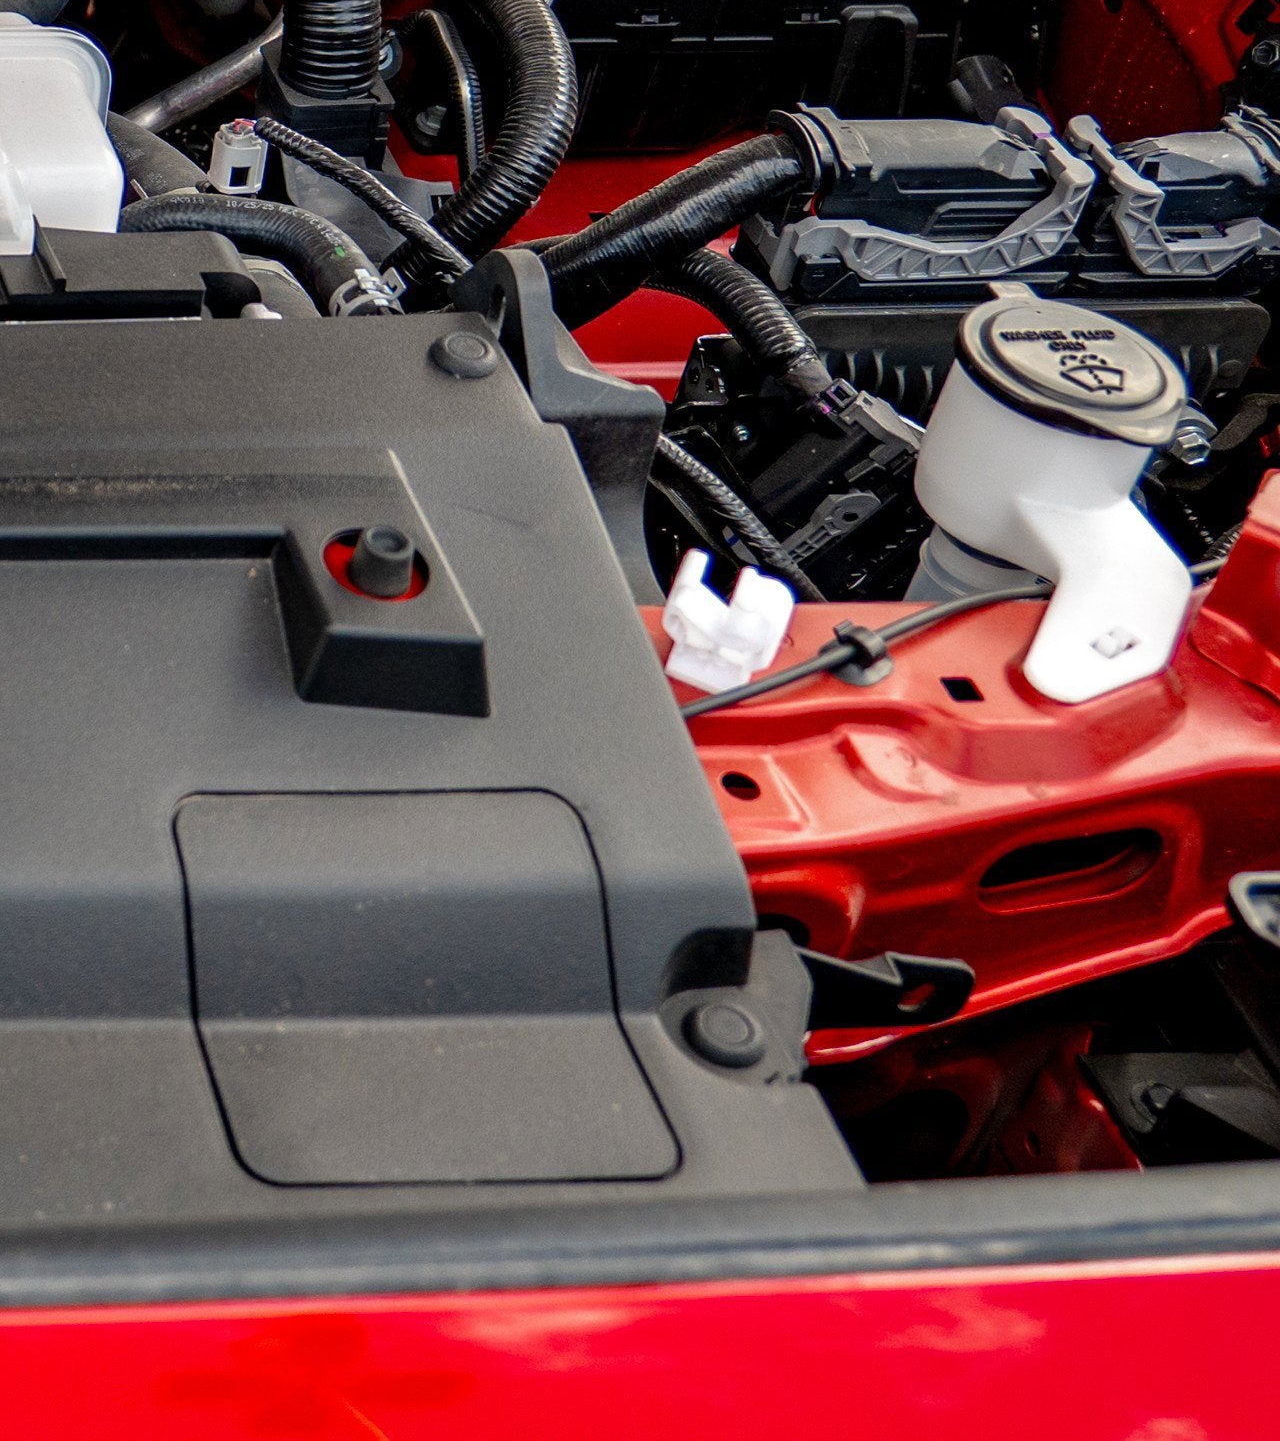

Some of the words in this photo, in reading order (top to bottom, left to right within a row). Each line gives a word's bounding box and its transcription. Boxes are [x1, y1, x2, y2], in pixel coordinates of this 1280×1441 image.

[998, 329, 1067, 342] WASHER
[1070, 329, 1116, 340] FLUID
[1047, 341, 1087, 352] ONLY
